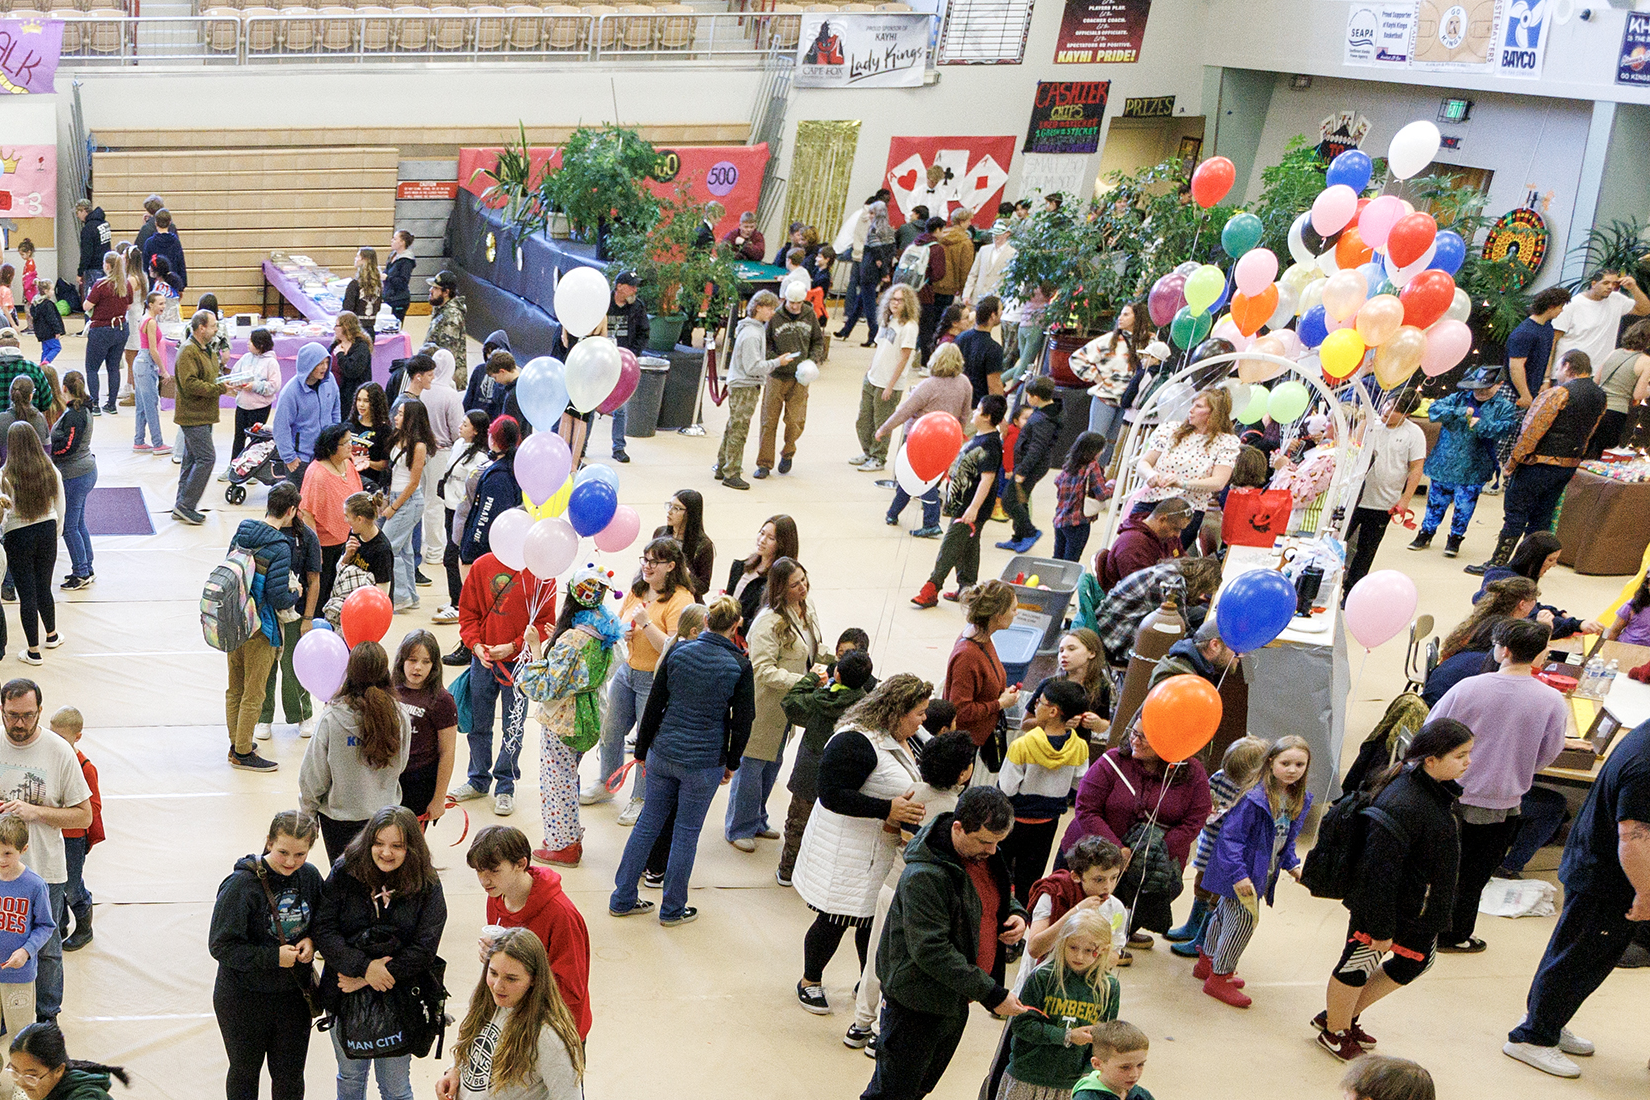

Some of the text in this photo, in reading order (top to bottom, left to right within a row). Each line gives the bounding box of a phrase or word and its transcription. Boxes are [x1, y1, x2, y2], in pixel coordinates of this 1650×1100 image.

[875, 33, 897, 41] KAYHI
[1351, 28, 1373, 38] SEAPA
[850, 43, 924, 78] Lady Kings
[1057, 50, 1136, 63] KAYHI PRIDE!
[1501, 50, 1536, 69] BAYCO
[802, 66, 844, 75] CAPE FOX
[1035, 82, 1110, 108] CASHIER
[1126, 97, 1174, 116] PRIZES
[708, 167, 736, 185] 500
[1044, 995, 1100, 1025] TIMBERS
[347, 1031, 402, 1050] MAN CITY
